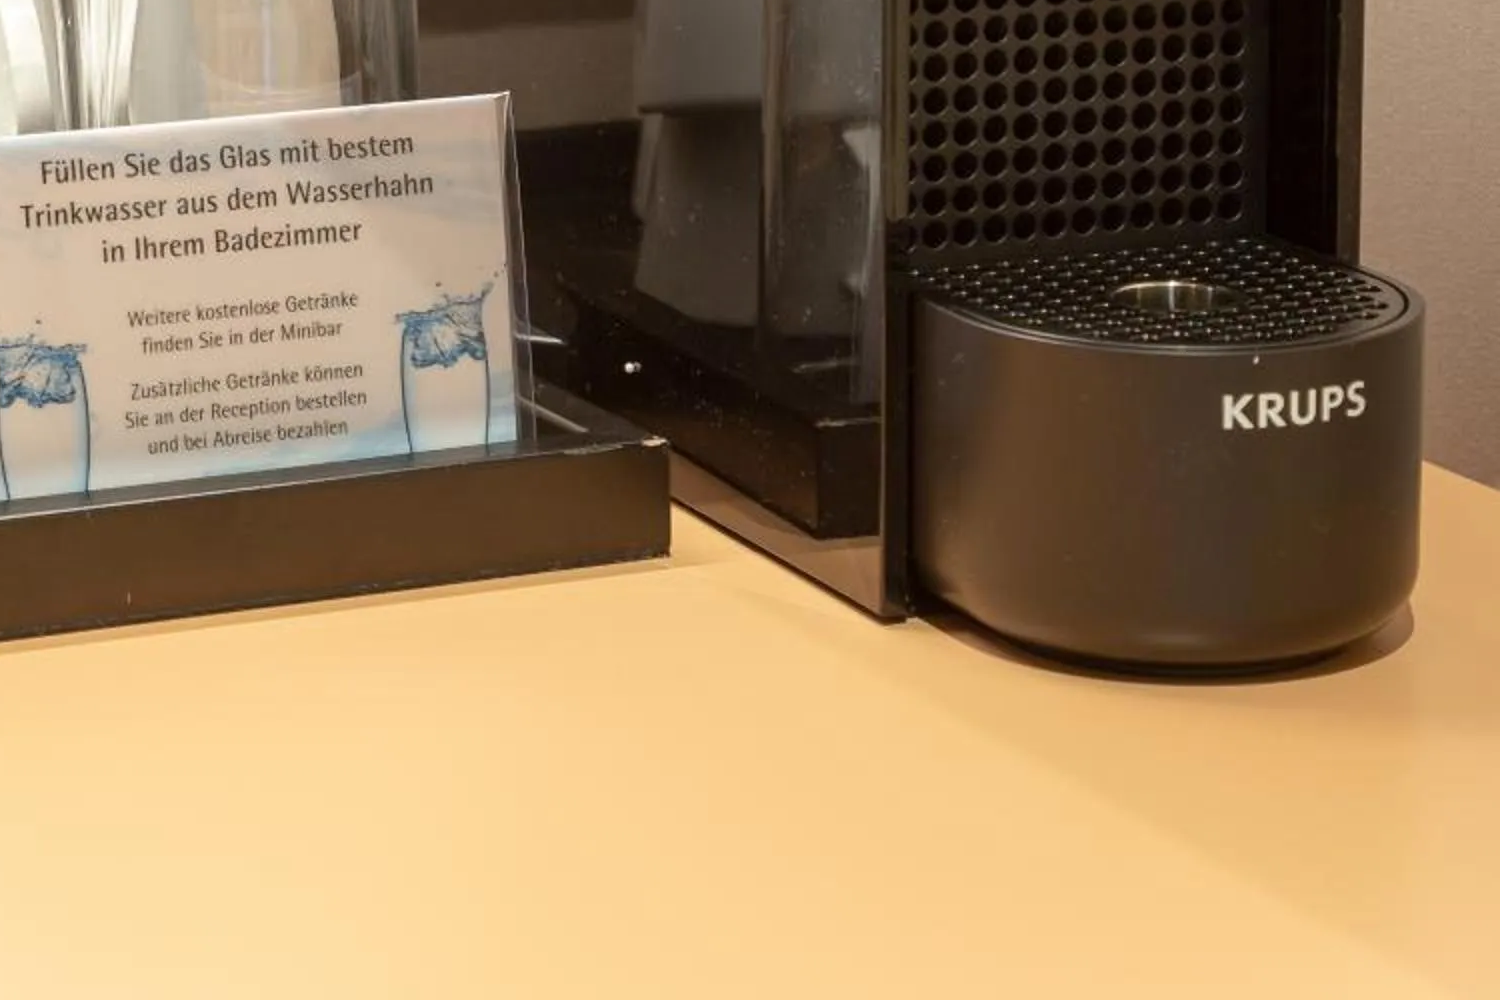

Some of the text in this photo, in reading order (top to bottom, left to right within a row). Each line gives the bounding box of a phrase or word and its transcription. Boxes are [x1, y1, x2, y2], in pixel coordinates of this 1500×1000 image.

[39, 135, 415, 185] Füllen Sie das Glas mit bestem
[19, 172, 434, 230] Trinkwasser aus dem Wasserhahn
[101, 223, 363, 265] in Ihrem Badezimmer
[126, 290, 359, 329] Weitere kostenlose Getränke
[141, 321, 343, 355] finden Sie in der Minibar
[131, 364, 364, 401] Zusätzliche Getränke können
[124, 389, 368, 430] Sie an der Reception bestellen
[1221, 380, 1367, 430] KRUPS
[147, 420, 348, 455] und bei Abreise bezahlen
